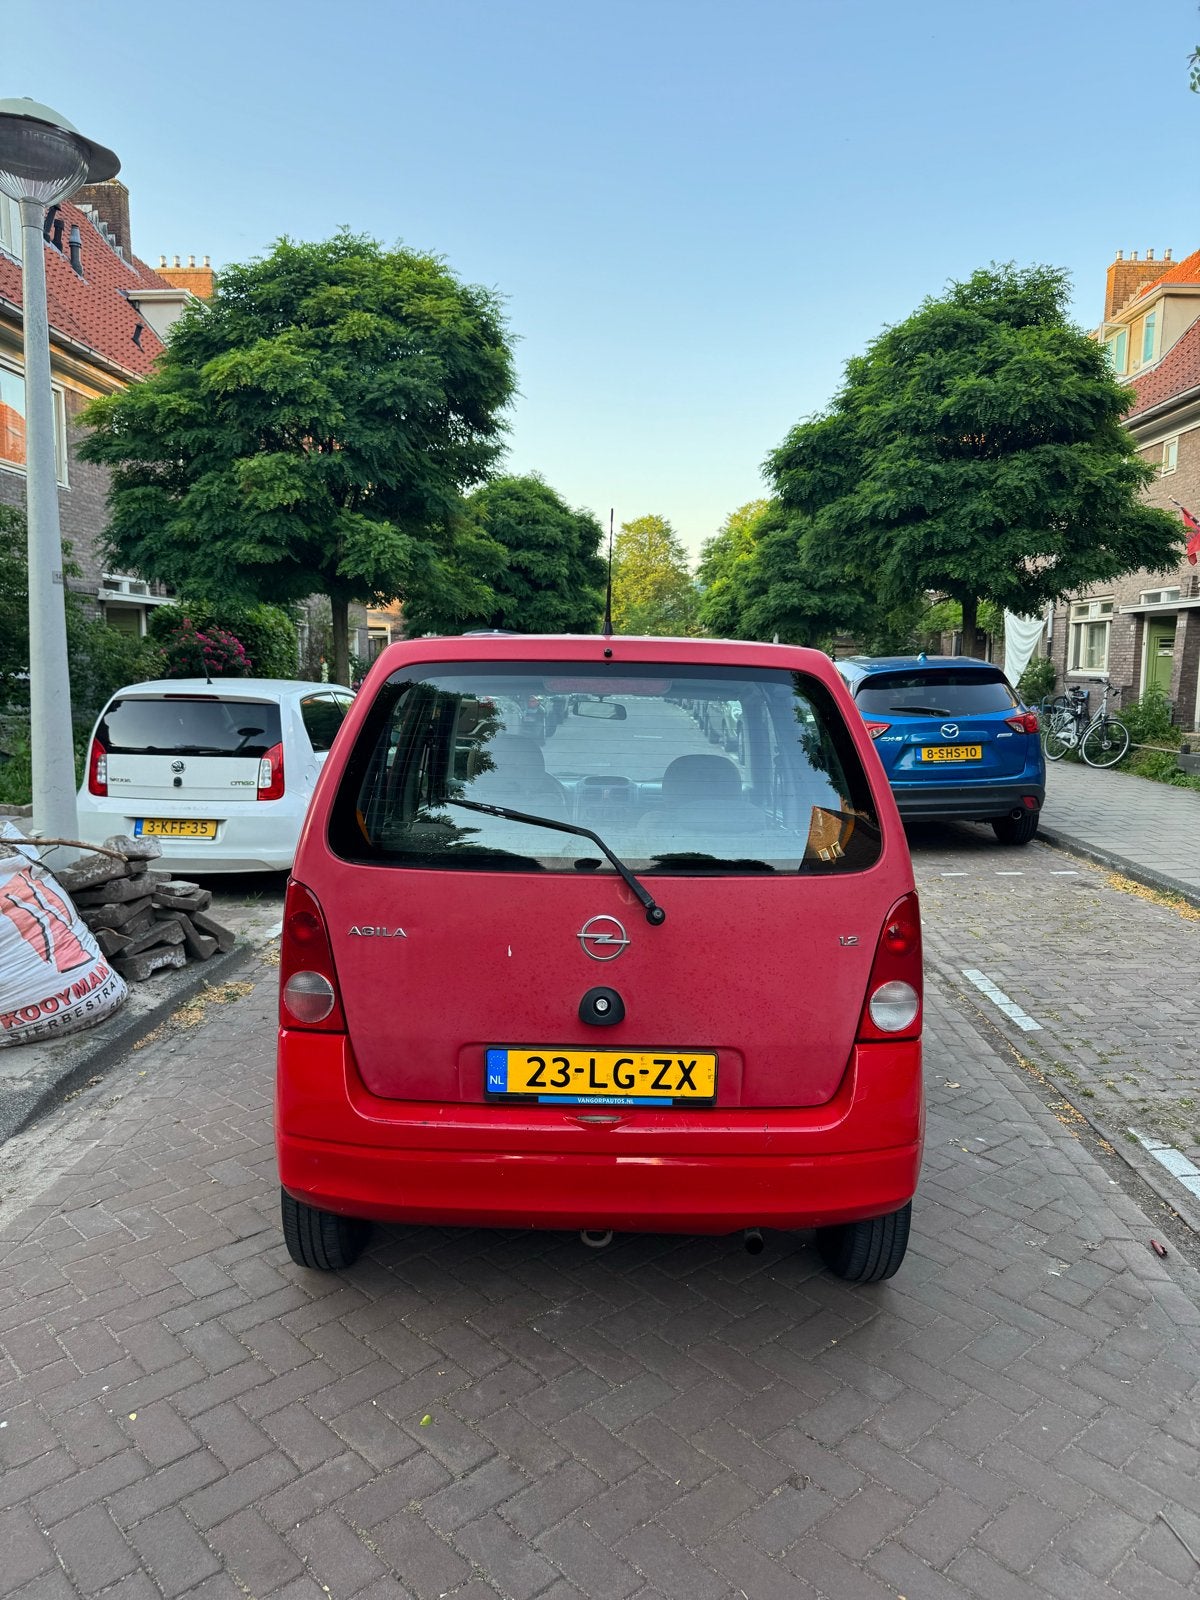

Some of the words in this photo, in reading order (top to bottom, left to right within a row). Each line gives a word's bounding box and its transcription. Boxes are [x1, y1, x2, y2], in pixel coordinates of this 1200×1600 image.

[927, 747, 977, 759] 8-SHS-10
[147, 821, 209, 834] 3-KFF-35
[347, 925, 408, 939] AGILA
[0, 962, 110, 1030] KOOYMAN
[489, 1075, 504, 1085] NL
[525, 1056, 698, 1091] 23-LG-ZX
[577, 1096, 634, 1105] VANGORPAUTOS.NL
